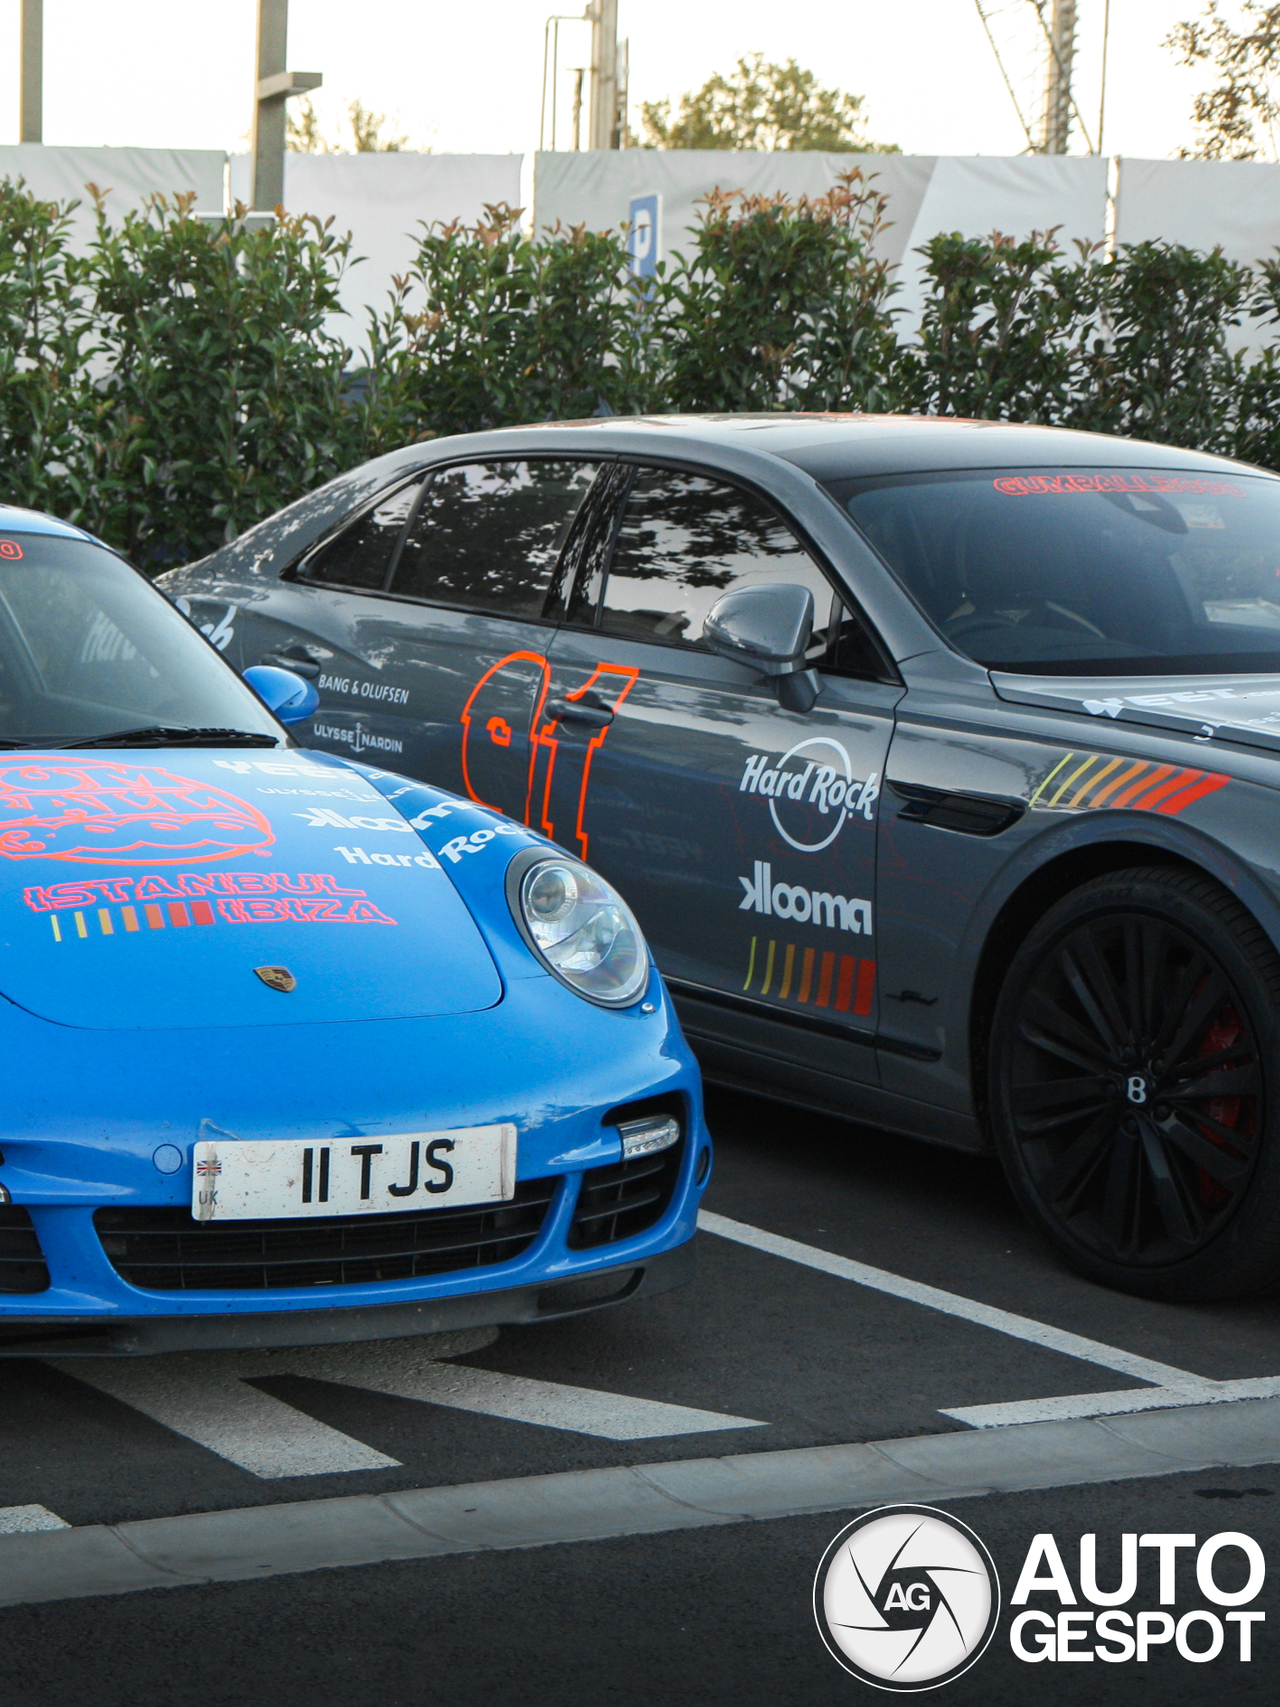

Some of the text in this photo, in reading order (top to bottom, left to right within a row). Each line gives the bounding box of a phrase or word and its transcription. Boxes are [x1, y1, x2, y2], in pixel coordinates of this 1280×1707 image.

[634, 209, 651, 277] P
[318, 674, 410, 704] BANG & OLUFSEN
[314, 723, 403, 753] ULYSSE NARDIN
[739, 754, 880, 820] Hard Rock
[333, 846, 442, 869] Hard
[23, 873, 367, 912] ISTANBUL
[217, 899, 399, 925] IBIZA
[351, 1138, 456, 1200] TJS
[199, 1190, 218, 1206] UK
